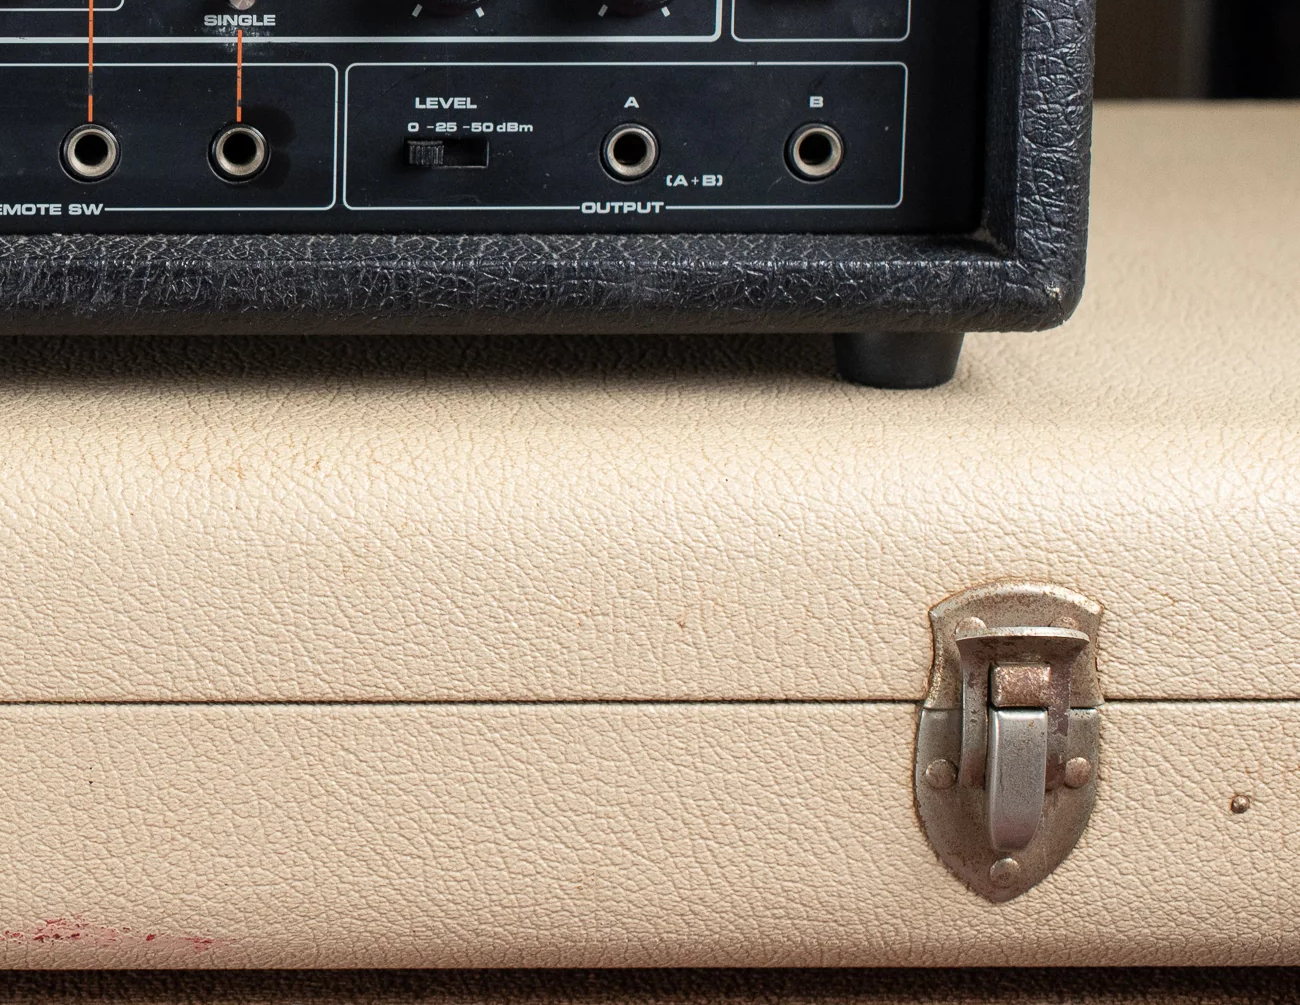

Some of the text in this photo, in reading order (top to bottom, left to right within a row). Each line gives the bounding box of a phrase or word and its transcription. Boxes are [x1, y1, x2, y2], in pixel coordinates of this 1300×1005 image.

[203, 14, 276, 26] SINGLE
[415, 97, 477, 108] LEVEL
[624, 97, 639, 108] A
[810, 96, 823, 107] B
[408, 122, 533, 132] 0 -25 -50 dBm
[69, 204, 103, 215] SW
[582, 202, 664, 213] OUTPUT
